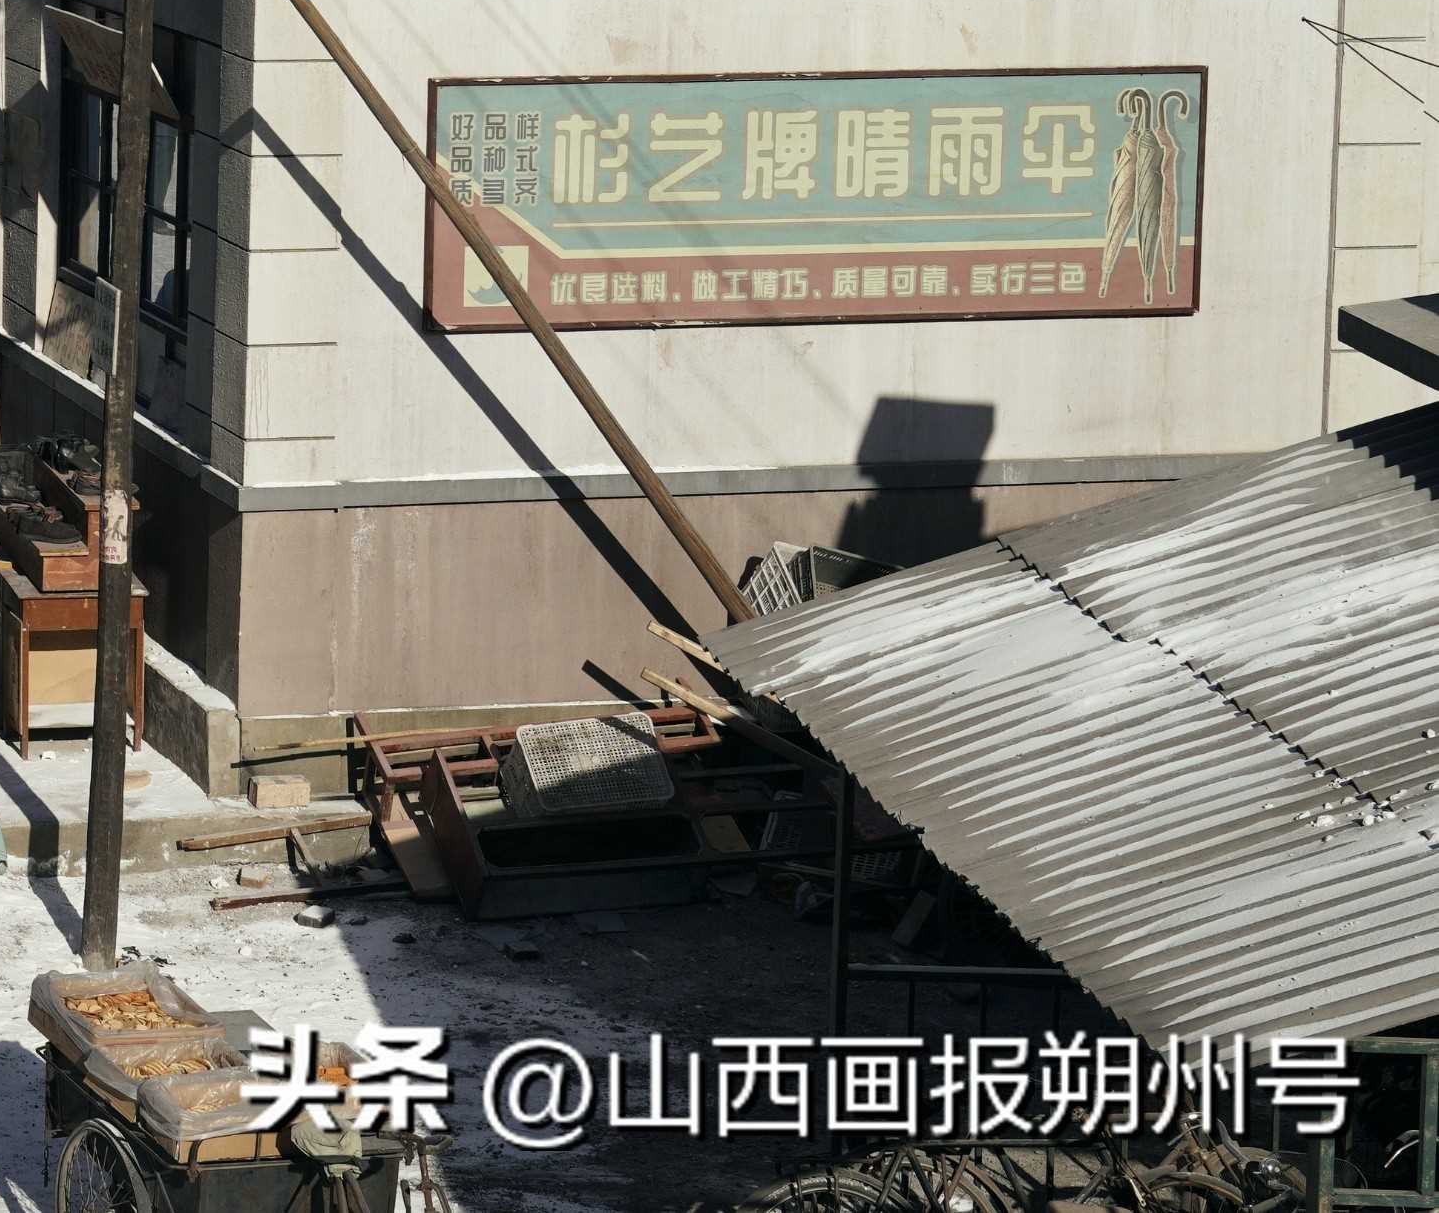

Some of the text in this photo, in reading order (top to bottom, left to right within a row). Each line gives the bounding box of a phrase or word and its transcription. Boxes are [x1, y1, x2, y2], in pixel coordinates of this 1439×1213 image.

[552, 105, 1096, 204] 杉艺牌晴雨伞
